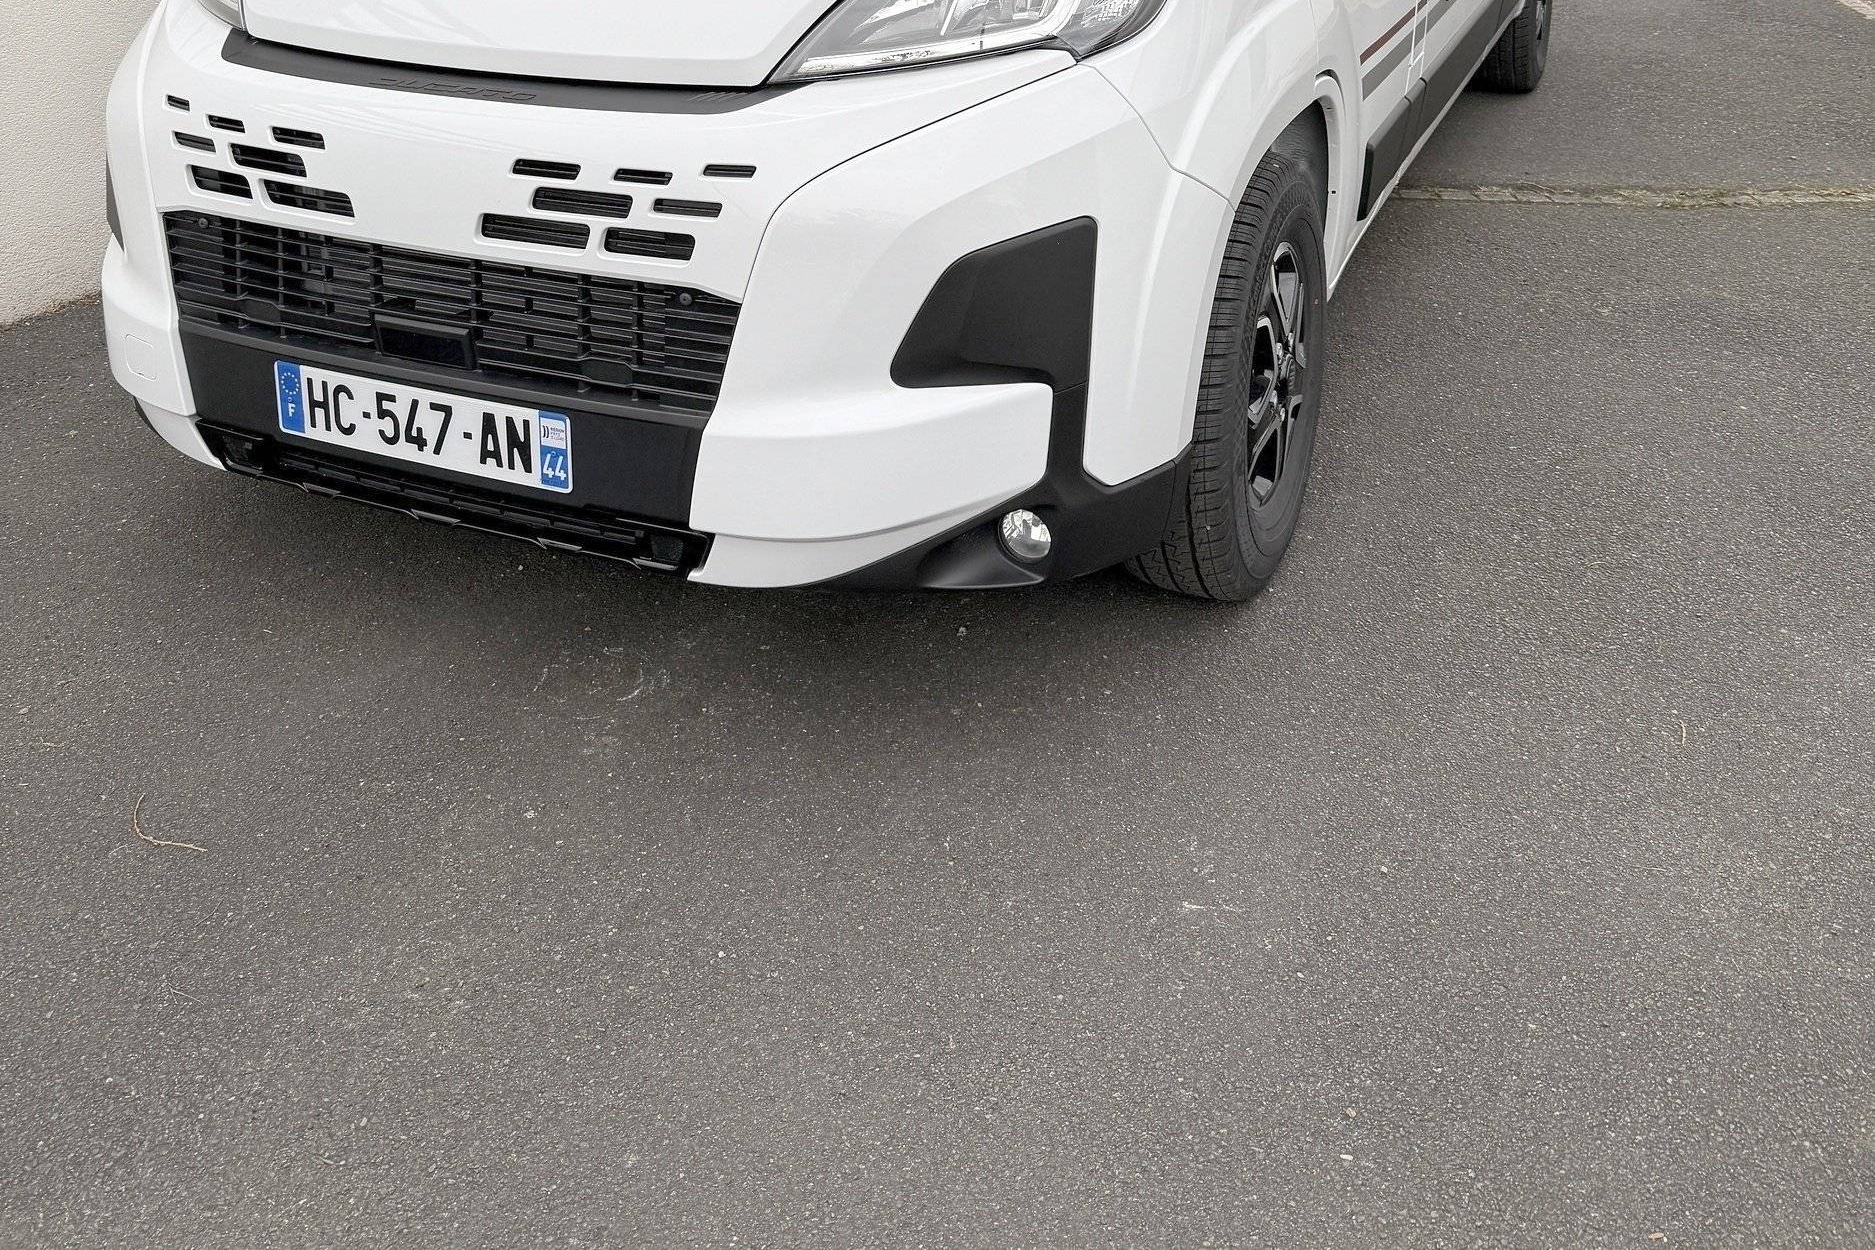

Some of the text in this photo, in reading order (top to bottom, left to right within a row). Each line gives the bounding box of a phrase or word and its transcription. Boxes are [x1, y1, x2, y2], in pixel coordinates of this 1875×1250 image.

[287, 404, 296, 417] F
[306, 377, 533, 474] HC-547-AN
[543, 453, 567, 481] 44
